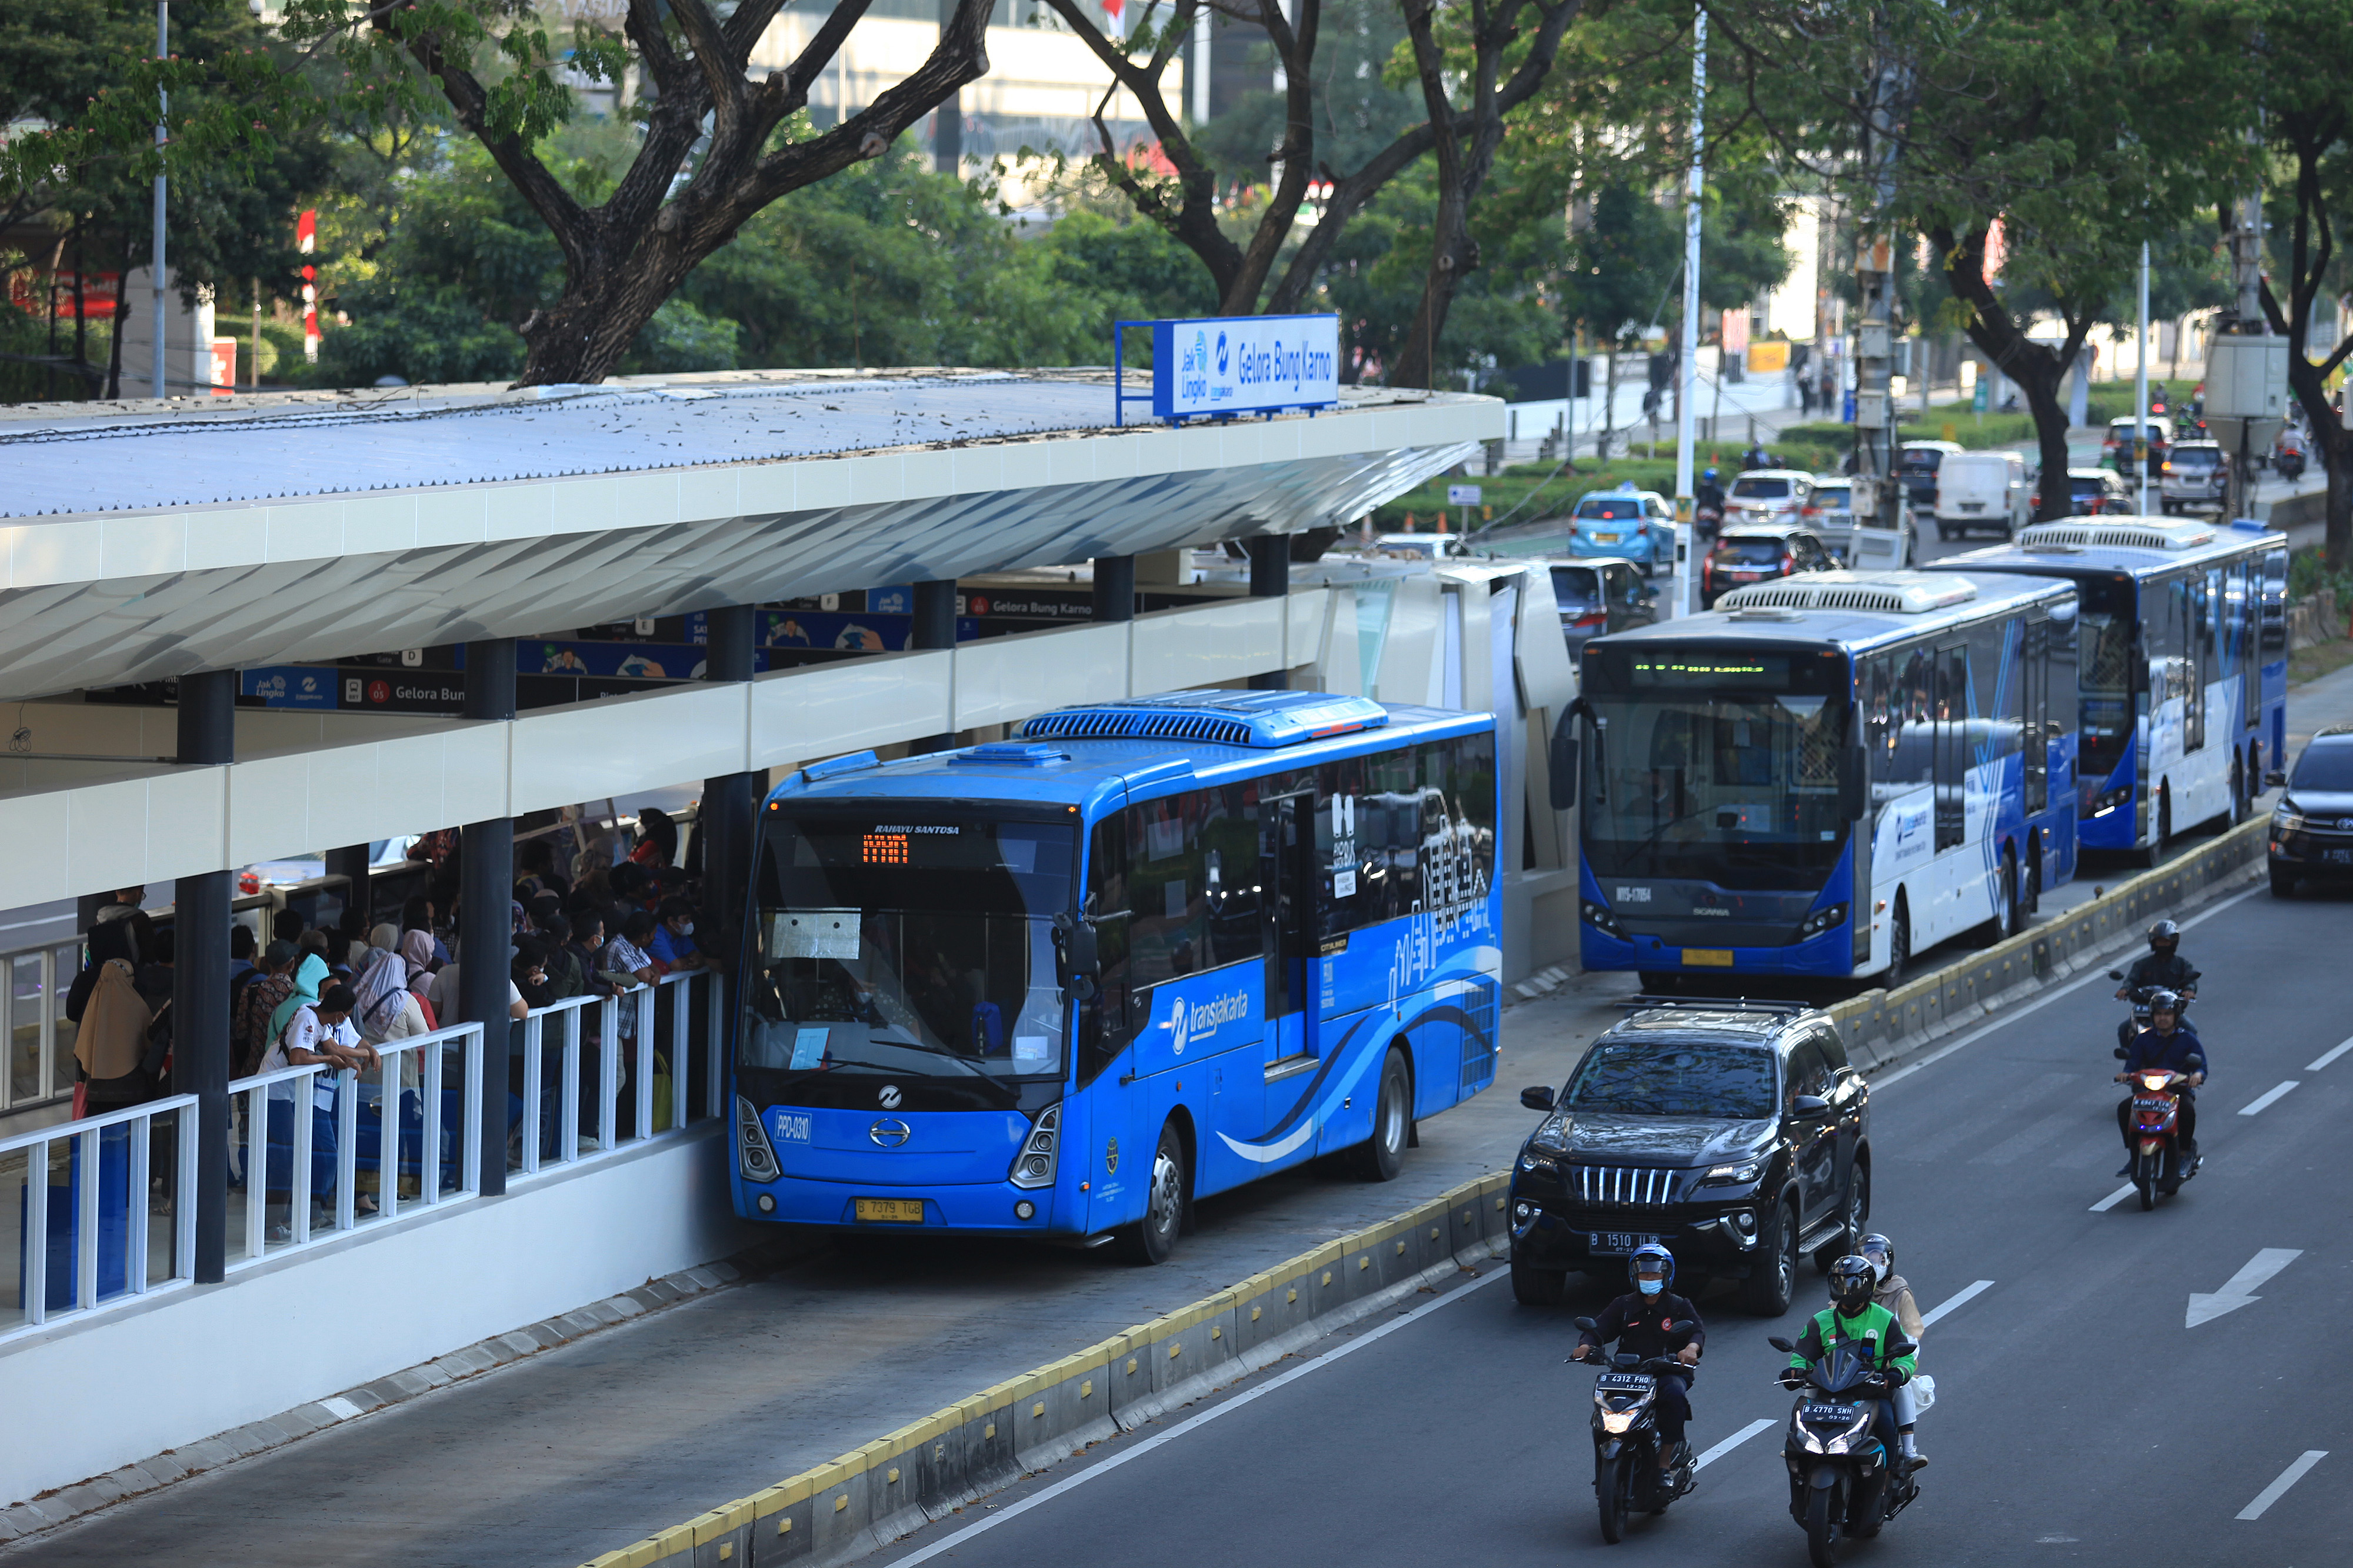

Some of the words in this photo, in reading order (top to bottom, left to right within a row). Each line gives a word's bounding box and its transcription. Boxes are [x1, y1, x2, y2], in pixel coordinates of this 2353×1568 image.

[1182, 348, 1195, 372] Jak
[1239, 342, 1271, 384] Gelora
[1275, 341, 1299, 392] Bung
[1302, 341, 1331, 383] Karno
[1182, 374, 1207, 405] Lingko
[993, 600, 1028, 612] Gelora
[1030, 601, 1058, 616] Bung
[1060, 603, 1092, 615] Karno
[408, 651, 415, 660] D
[256, 680, 271, 689] Jak
[256, 688, 285, 698] Lingko
[373, 690, 384, 699] 05
[396, 686, 437, 700] Gelora
[874, 825, 914, 833] RAHAYU
[914, 826, 959, 835] SANTOSA
[1189, 989, 1248, 1043] transjakarta
[777, 1115, 808, 1140] PPD-0310
[858, 1201, 865, 1213] B
[871, 1202, 895, 1213] 7379
[902, 1202, 921, 1214] TGB
[1591, 1233, 1598, 1246] B
[1607, 1233, 1631, 1246] 1510
